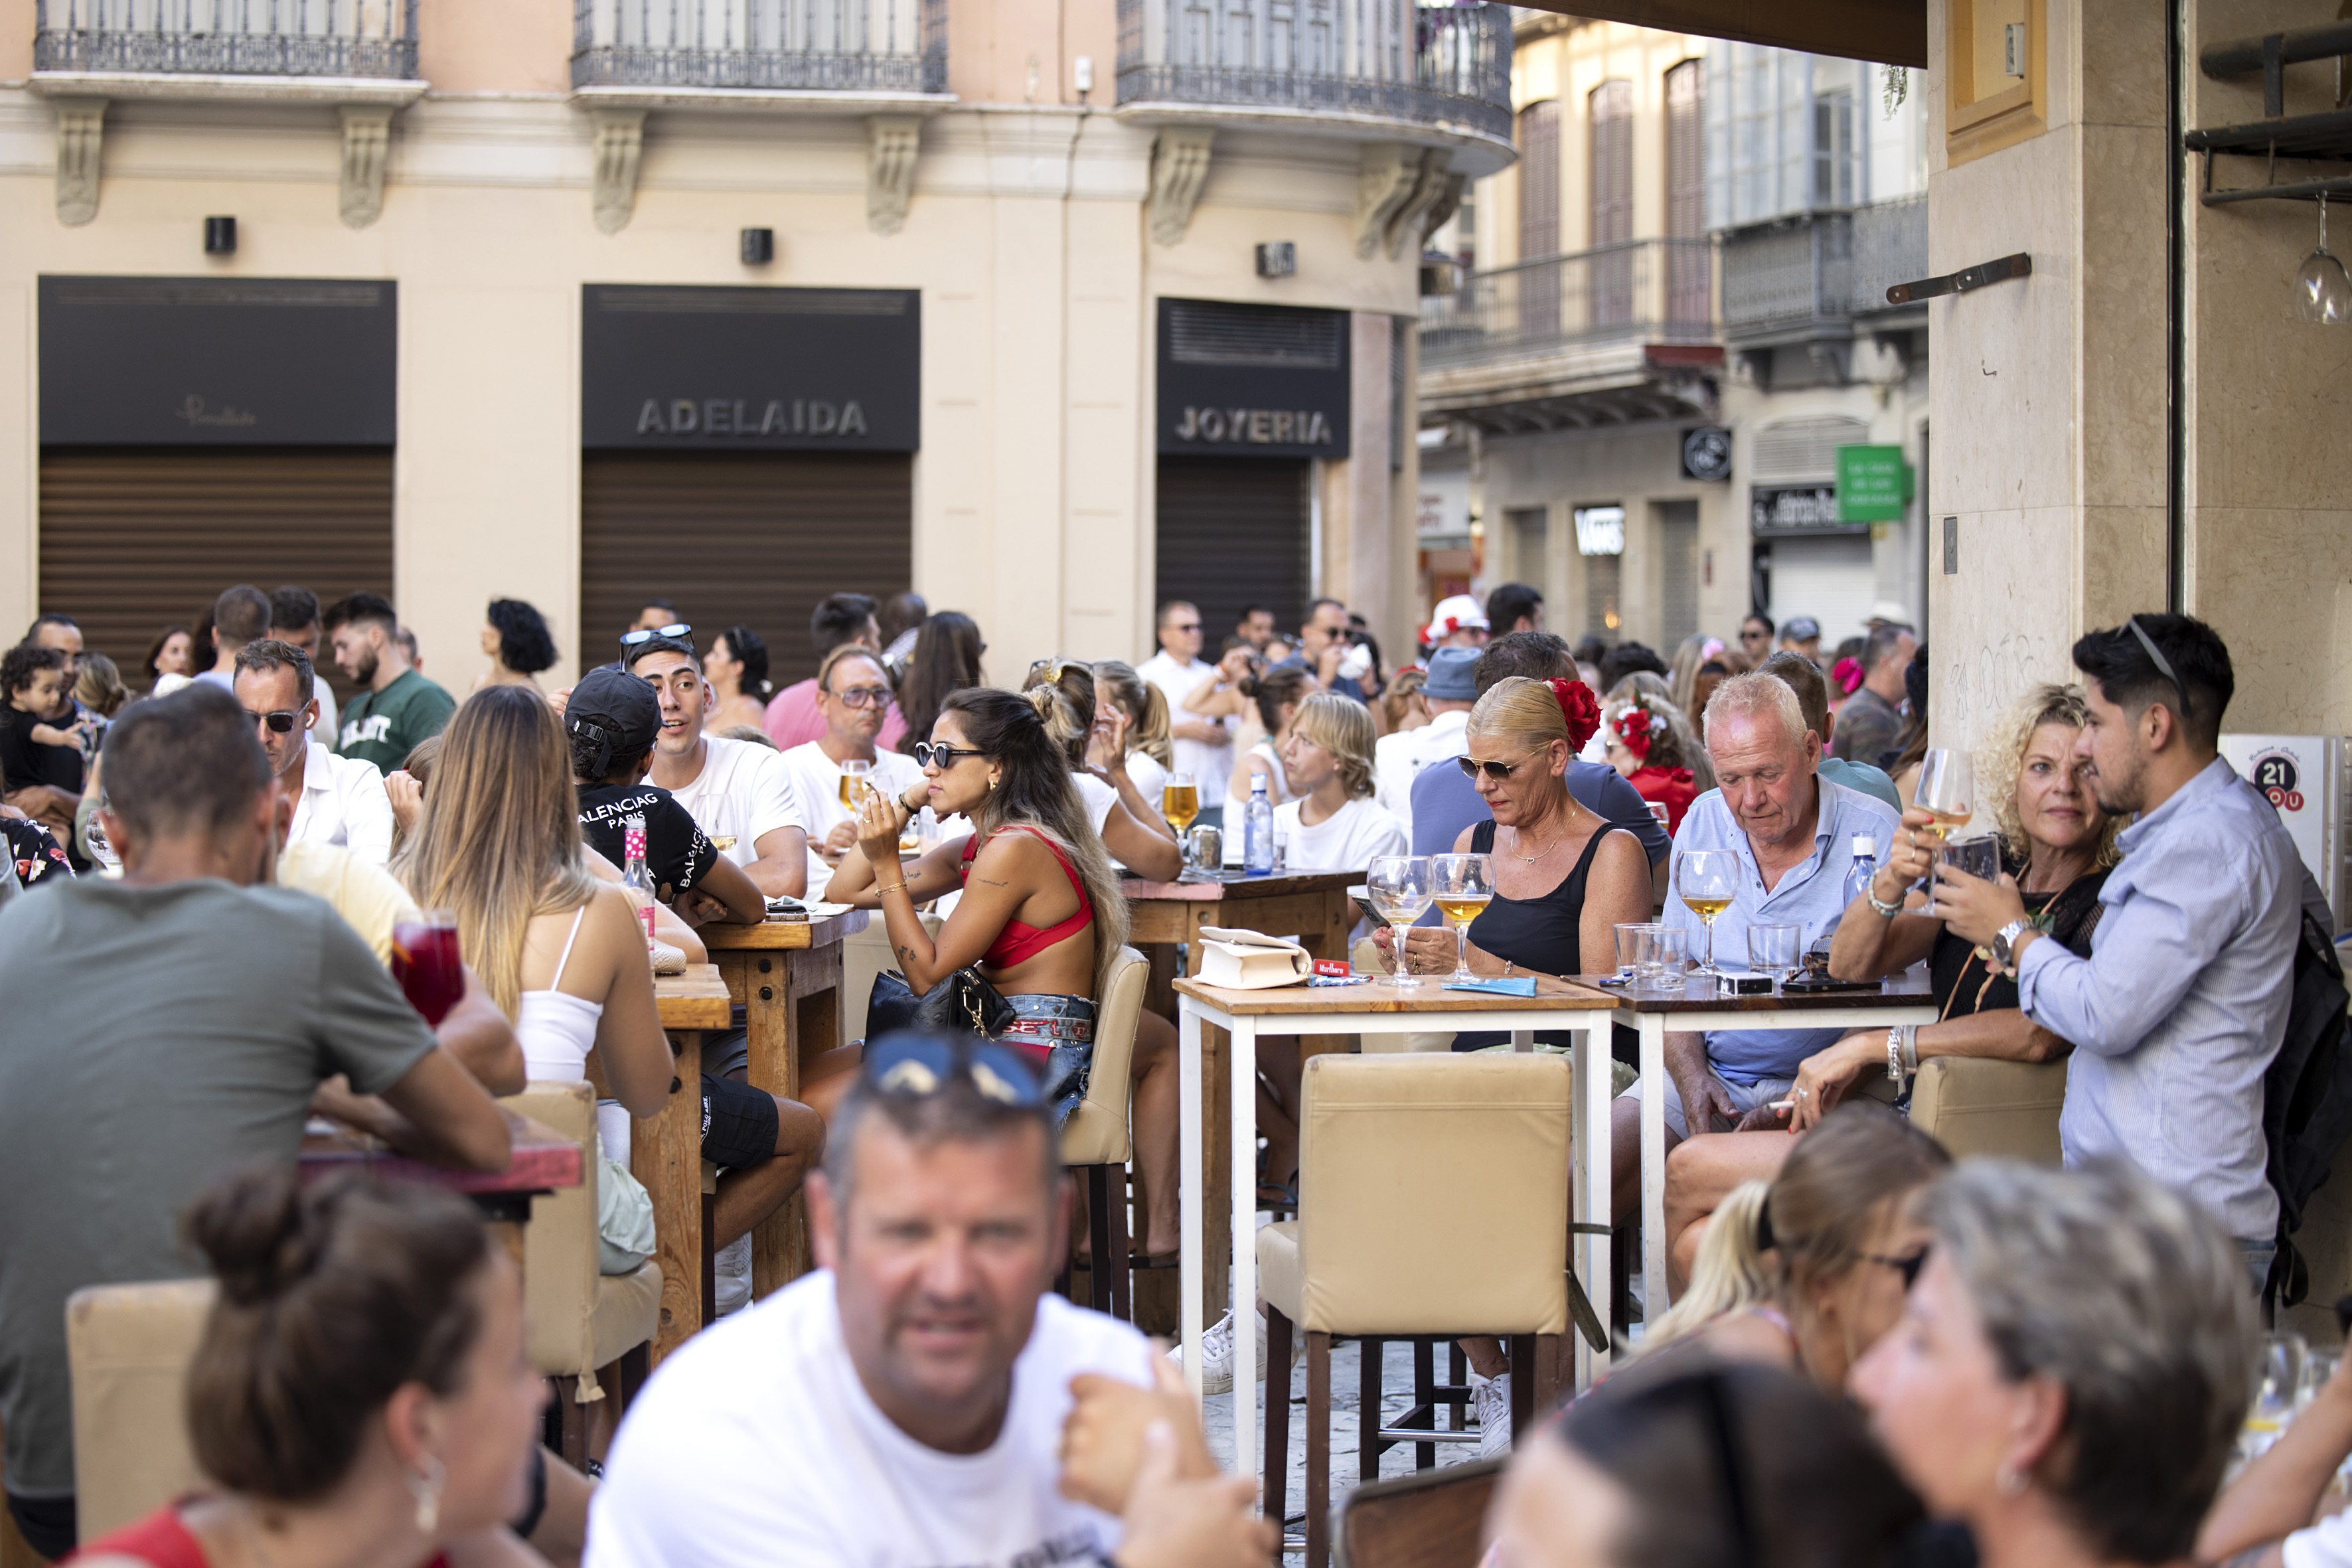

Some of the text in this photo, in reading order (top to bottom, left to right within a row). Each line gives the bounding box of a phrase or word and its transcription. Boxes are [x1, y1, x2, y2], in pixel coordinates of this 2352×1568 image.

[637, 400, 868, 435] ADELAIDA
[1174, 406, 1332, 445] JOYERIA
[2263, 762, 2285, 785] 21
[577, 793, 659, 823] ALENCIAG
[2270, 791, 2298, 807] OU
[1319, 963, 1344, 975] Marlboro
